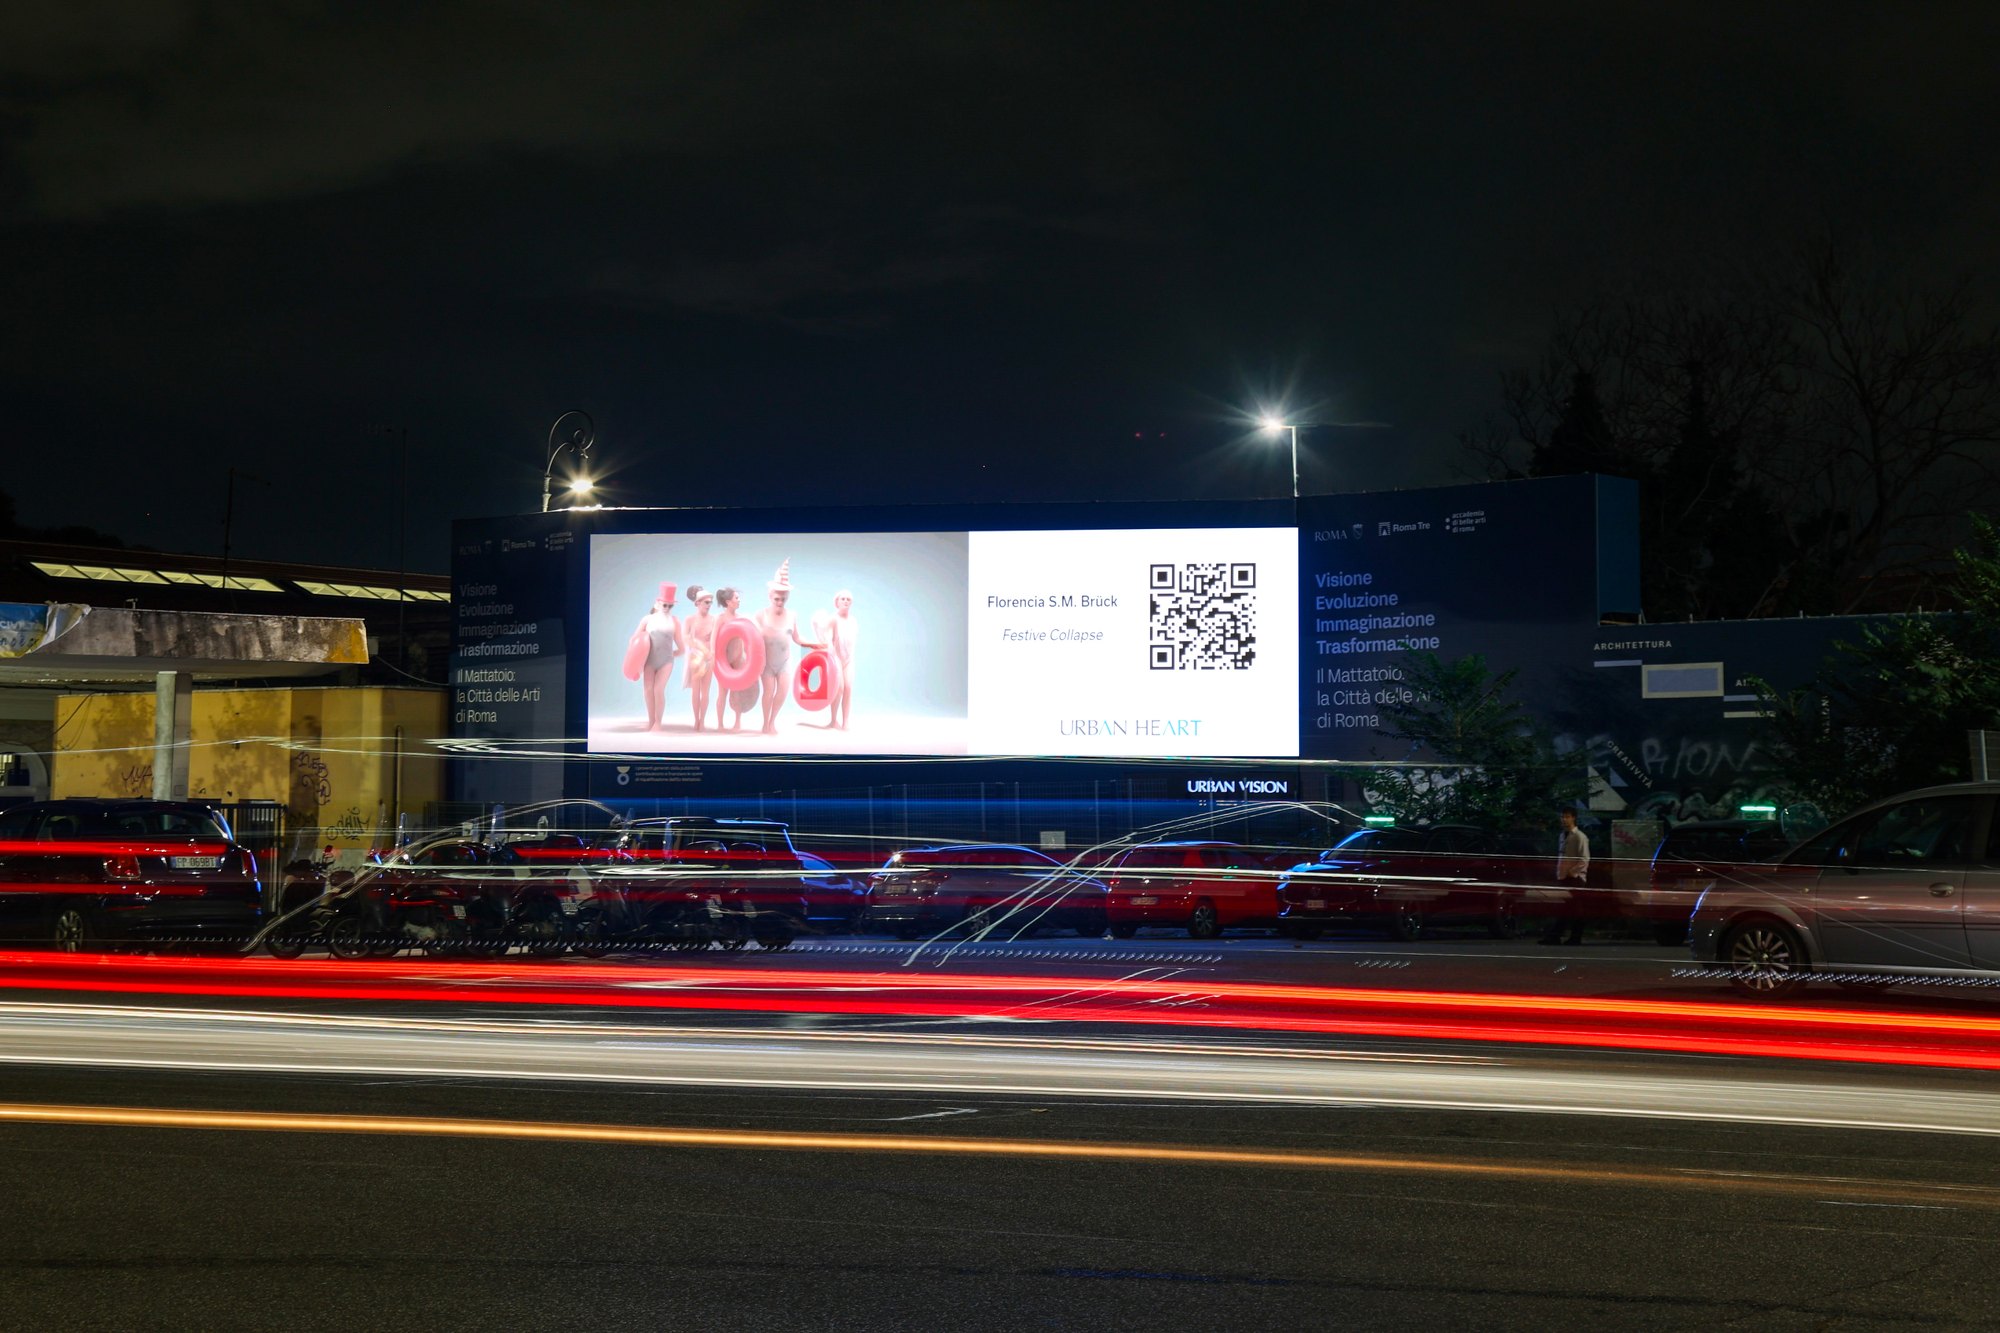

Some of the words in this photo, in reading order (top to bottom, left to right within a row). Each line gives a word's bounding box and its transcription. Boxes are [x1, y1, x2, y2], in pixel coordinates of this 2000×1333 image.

[1452, 510, 1485, 519] accademia
[1393, 523, 1416, 533] Roma
[1417, 521, 1431, 531] Tre
[1314, 529, 1348, 542] ROMA
[1315, 571, 1373, 588] Visione
[459, 583, 498, 597] Visione
[987, 595, 1045, 608] Florencia
[1048, 595, 1077, 608] S.M.
[1081, 594, 1118, 608] Brück
[1316, 591, 1399, 610] Evoluzione
[458, 602, 514, 617] Evoluzione
[458, 620, 538, 638] Immaginazione
[1316, 611, 1436, 633] Immaginazione
[1002, 628, 1046, 641] Festive
[1050, 628, 1104, 643] Collapse
[457, 641, 540, 657] Trasformazione
[1316, 635, 1440, 655] Trasformazione
[1594, 640, 1672, 651] ARCHITETTURA
[457, 669, 463, 683] Il
[464, 668, 516, 683] Mattatoio:
[1317, 667, 1324, 683] Il
[457, 689, 466, 703] la
[467, 689, 493, 703] Città
[494, 688, 520, 702] delle
[521, 688, 541, 701] Arti
[1317, 690, 1330, 706] la
[1333, 688, 1371, 706] Città
[1374, 687, 1413, 704] delle
[456, 709, 466, 723] di
[467, 709, 498, 723] Roma
[1317, 712, 1331, 729] di
[1335, 713, 1380, 728] Roma
[1060, 719, 1127, 736] URBAN
[1135, 719, 1202, 736] HEART
[1187, 780, 1235, 793] URBAN
[1239, 780, 1287, 794] VISION
